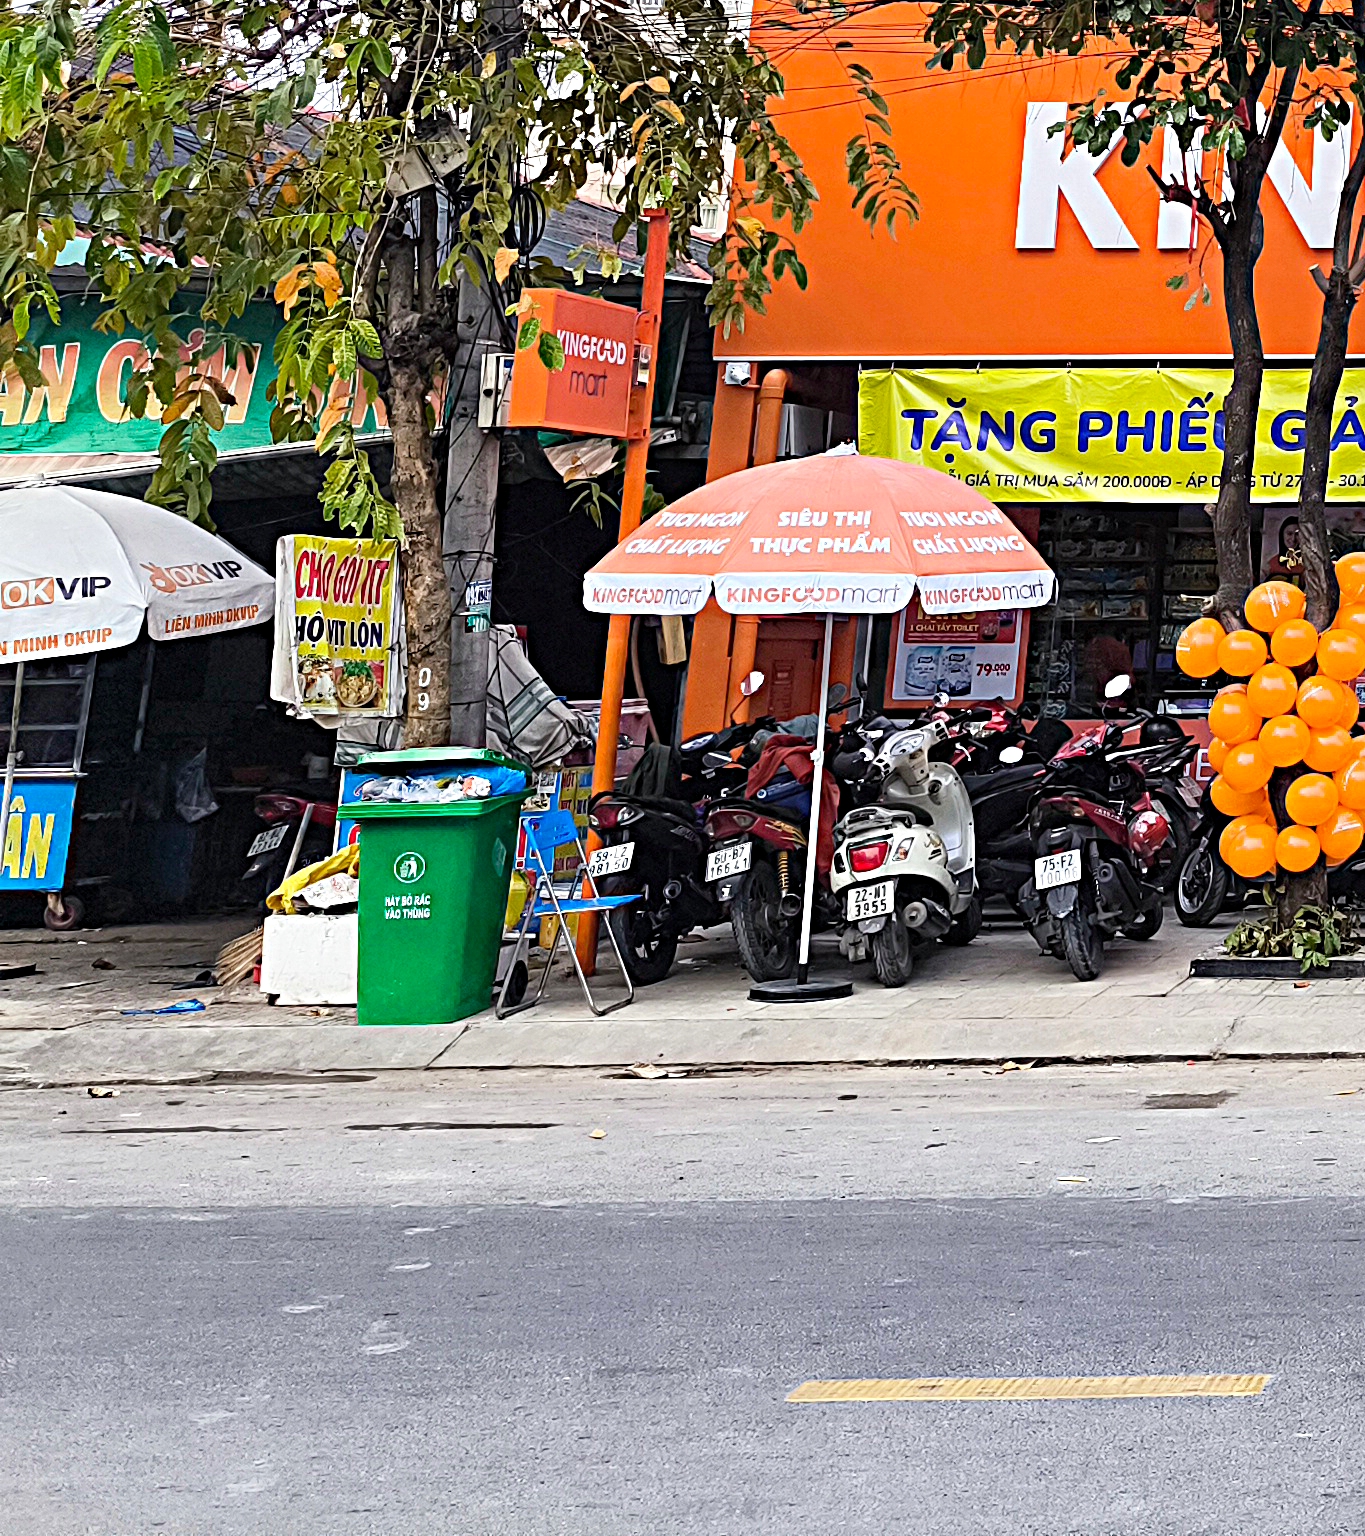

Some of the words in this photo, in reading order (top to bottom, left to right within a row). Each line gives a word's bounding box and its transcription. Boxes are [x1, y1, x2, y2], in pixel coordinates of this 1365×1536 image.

[556, 329, 627, 365] KINGFOOD
[569, 368, 608, 398] mart
[900, 397, 1057, 464] TẶNG
[964, 469, 991, 488] GIÁ
[995, 473, 1020, 490] TRỊ
[1022, 473, 1060, 488] MUA
[1062, 470, 1099, 488] SẮM
[1102, 474, 1172, 488] 200.000Đ
[1185, 470, 1208, 488] ÁP
[1260, 471, 1284, 488] TỪ
[694, 510, 750, 528] NGON
[778, 508, 829, 527] SIÊU
[833, 510, 872, 528] THỊ
[947, 508, 1003, 527] NGON
[750, 536, 813, 556] THỰC
[817, 532, 892, 555] PHẨM
[912, 533, 959, 556] CHẤT
[962, 535, 1026, 557] LƯỢNG
[166, 560, 243, 589] OKVIP
[2, 575, 112, 608] OKVIP
[726, 582, 902, 604] KINGFOODmart
[194, 611, 224, 631] MINH
[13, 633, 59, 656] MINH
[64, 627, 113, 648] OKVIP
[349, 617, 384, 654] LỘN
[413, 893, 431, 906] RÁC
[402, 906, 431, 919] THÙNG
